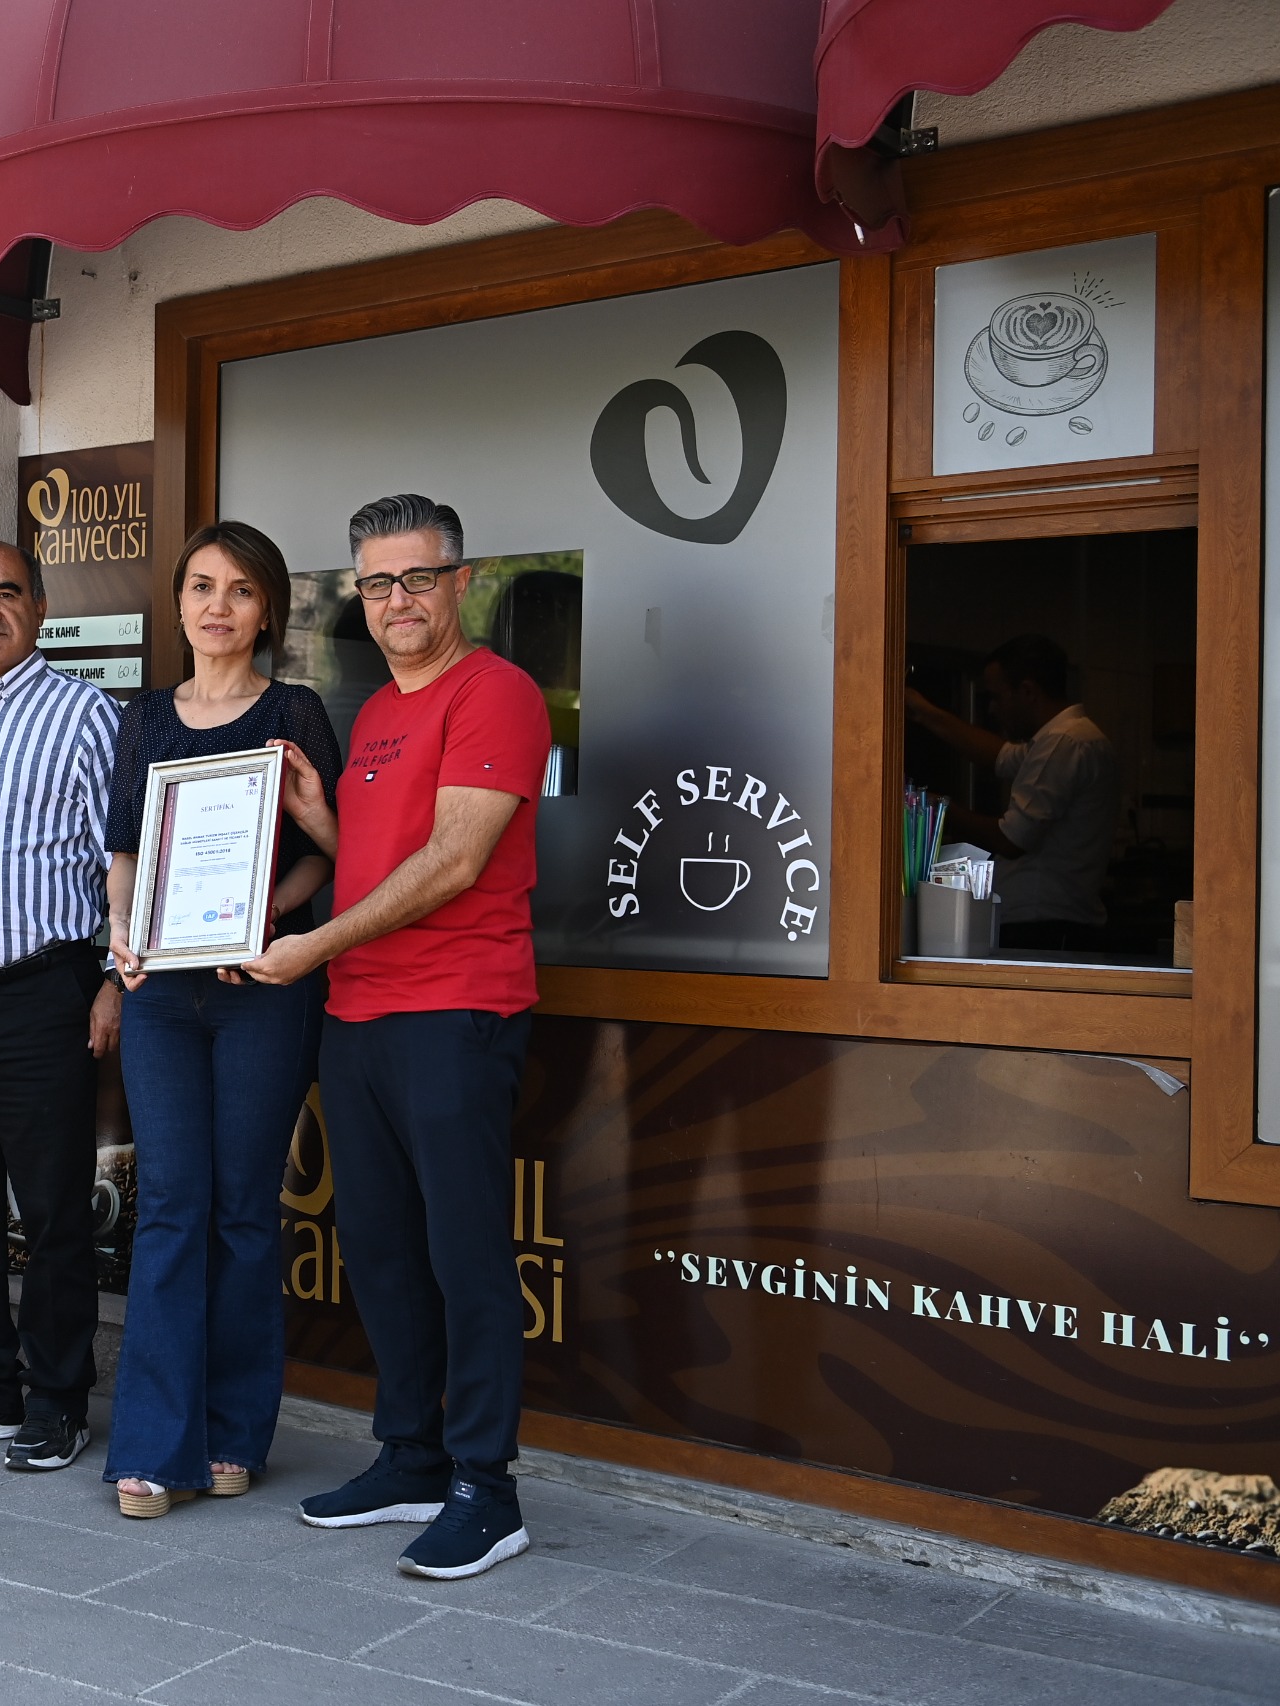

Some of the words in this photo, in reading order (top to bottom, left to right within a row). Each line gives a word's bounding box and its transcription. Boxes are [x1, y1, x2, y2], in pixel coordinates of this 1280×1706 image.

[70, 482, 147, 524] 100.YIL
[39, 627, 54, 639] LTRE
[55, 626, 80, 638] KAHVE
[118, 622, 132, 636] 60
[80, 667, 105, 680] KAHVE
[117, 665, 130, 678] 60
[363, 734, 408, 752] TOMMY
[351, 749, 401, 768] HILFIGER
[200, 803, 235, 812] SERTİFİKA
[607, 788, 664, 918] SELF
[911, 1284, 1079, 1339] KAHVE
